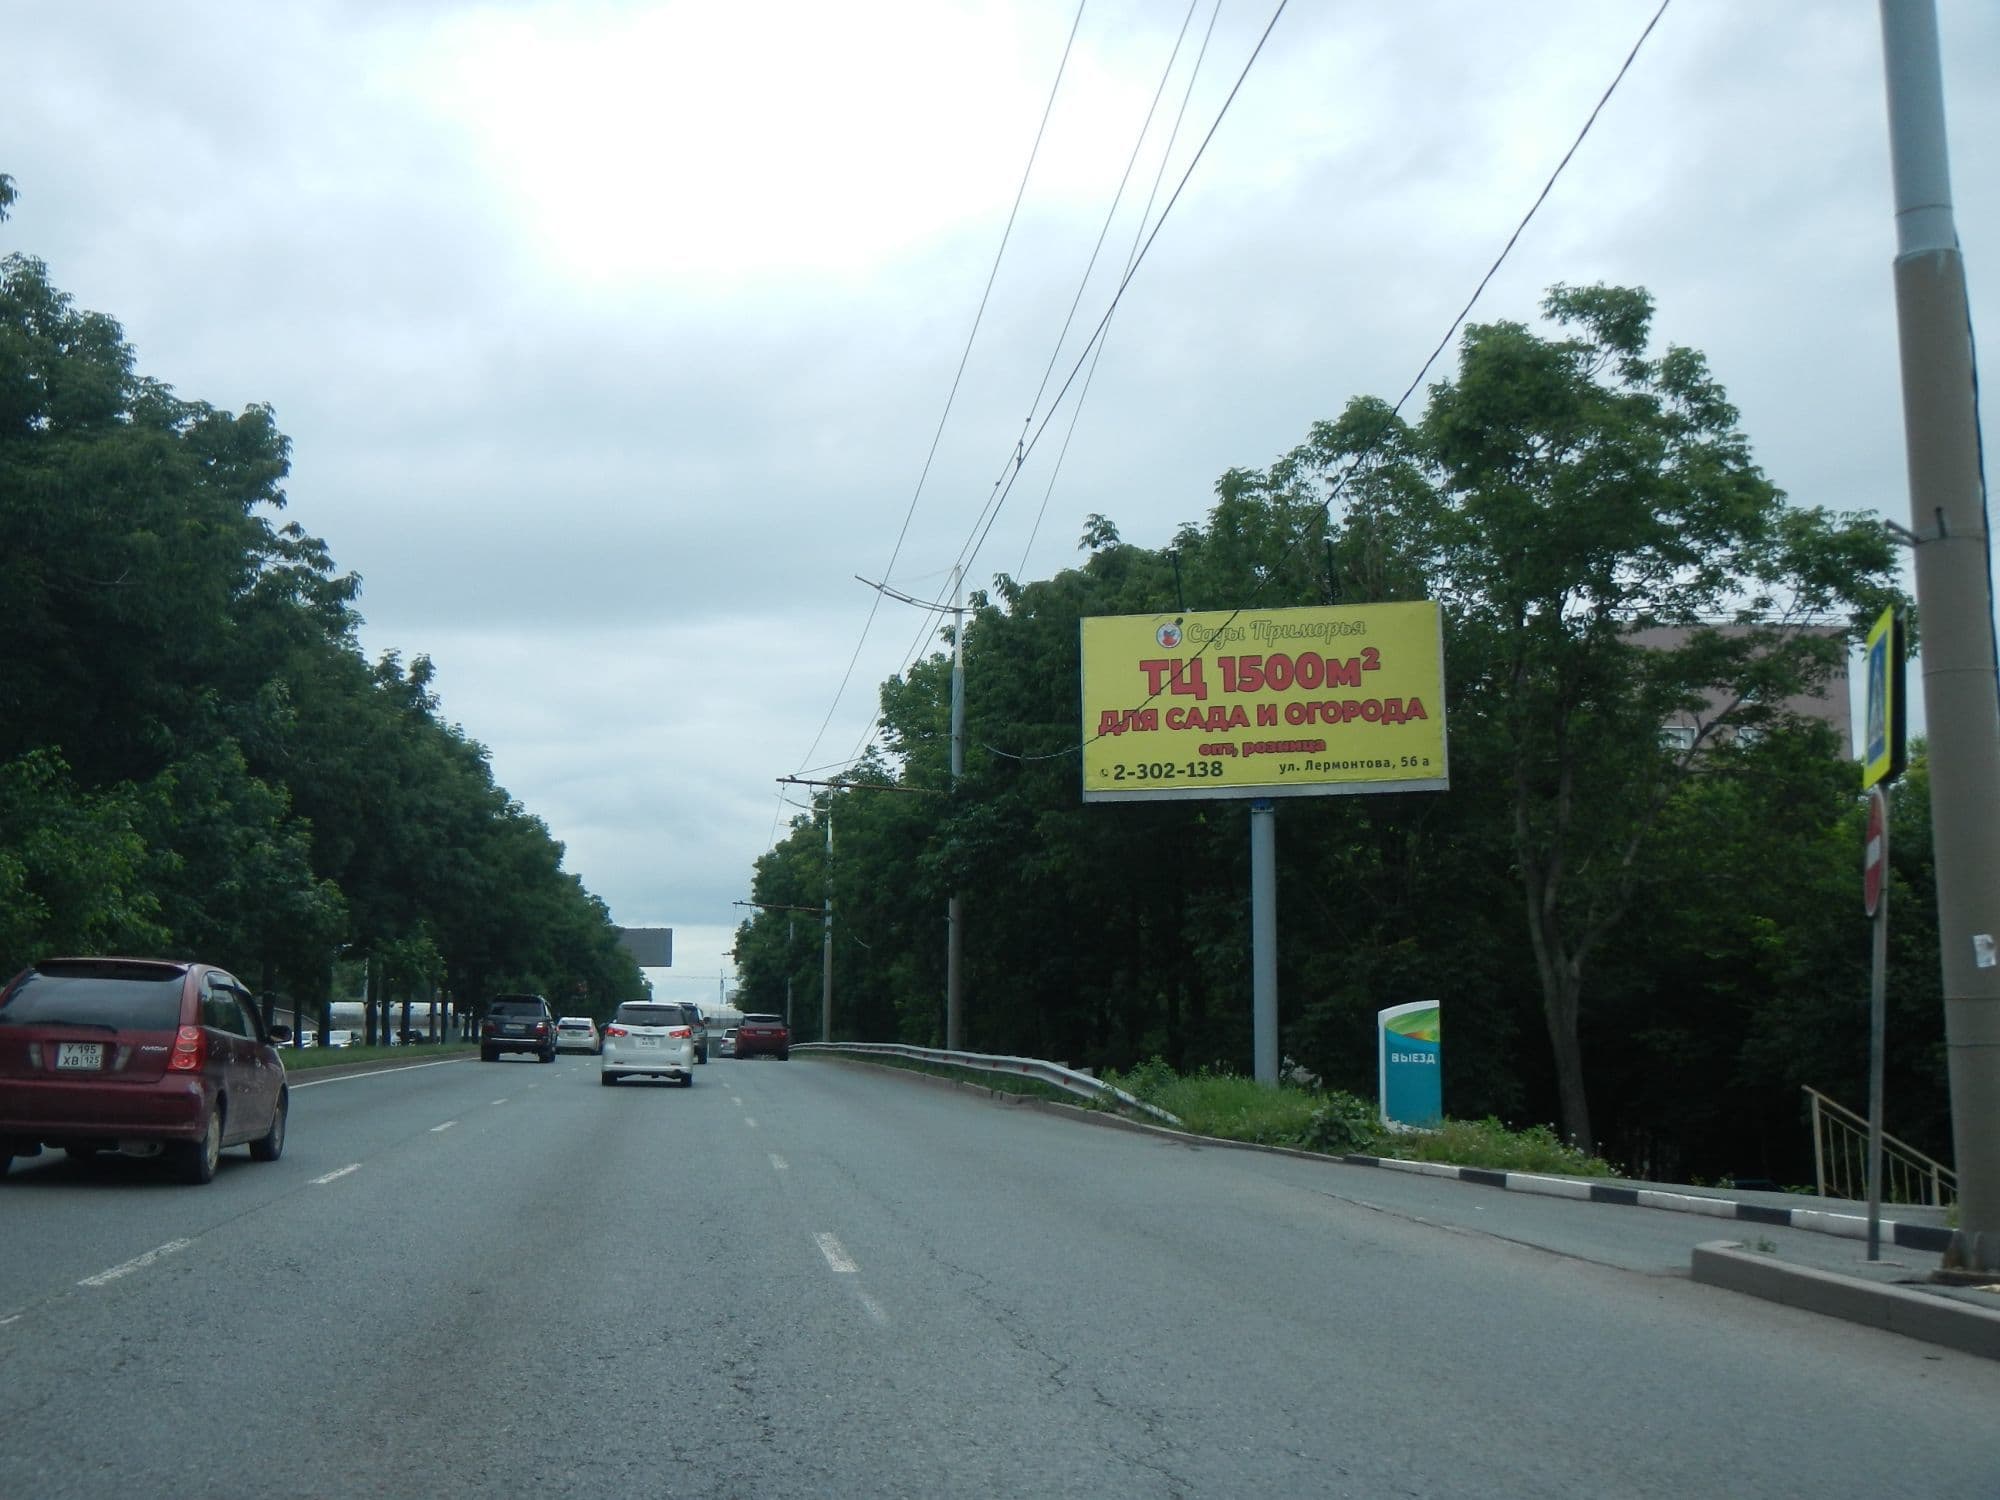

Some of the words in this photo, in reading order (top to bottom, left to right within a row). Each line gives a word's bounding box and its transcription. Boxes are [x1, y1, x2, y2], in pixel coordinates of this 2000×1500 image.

[1187, 623, 1246, 650] Сады
[1250, 619, 1367, 648] Приморья
[1139, 657, 1208, 701] ТЦ
[1098, 708, 1159, 736] ДЛЯ
[1165, 704, 1251, 732] САДА
[1256, 703, 1279, 727] И
[1284, 697, 1429, 726] ОГОРОДА
[1242, 738, 1327, 757] розница
[1114, 760, 1224, 781] 2-302-138
[1279, 762, 1301, 775] ул.
[1304, 757, 1397, 773] Лермонтова,
[79, 1045, 97, 1054] 195
[1391, 1052, 1436, 1065] ВЫЕЗД
